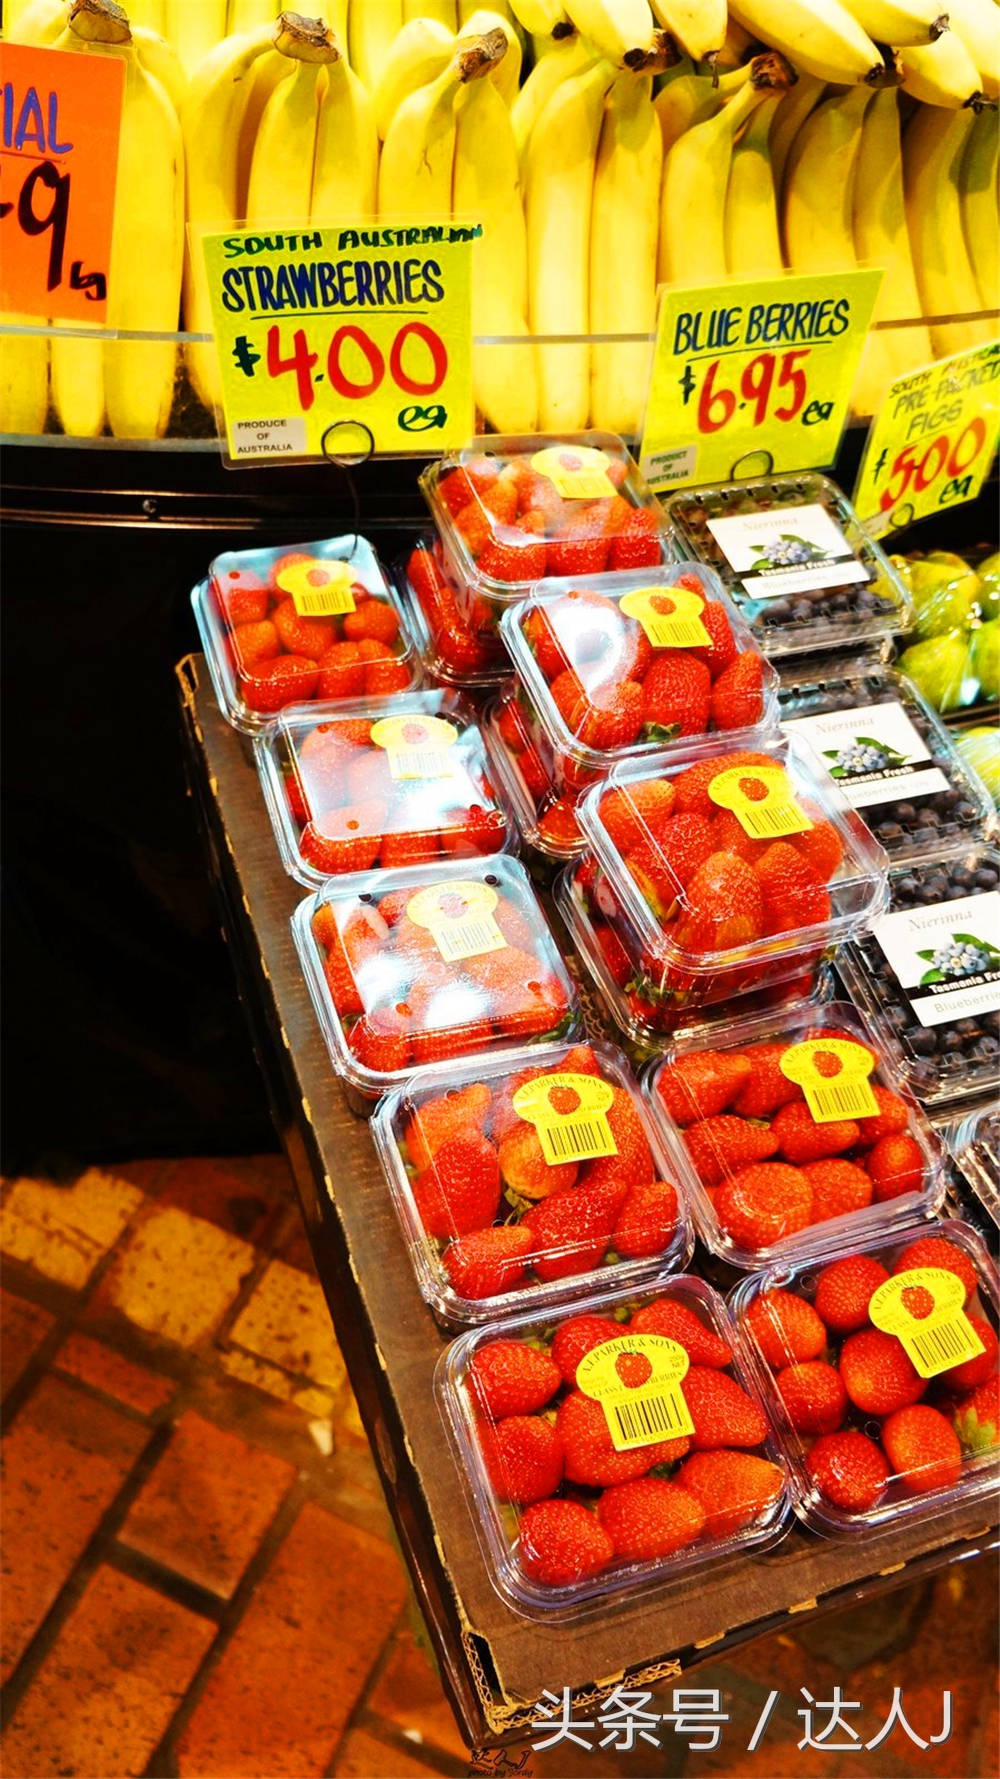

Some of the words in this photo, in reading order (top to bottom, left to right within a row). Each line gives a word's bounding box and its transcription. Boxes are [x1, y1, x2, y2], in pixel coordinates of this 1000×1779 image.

[0, 83, 74, 154] IAL
[223, 232, 323, 258] SOUTH
[222, 259, 445, 313] STRAWBERRIES
[673, 306, 743, 356] BLUE
[745, 298, 850, 345] BERRIES
[802, 400, 835, 426] ea
[906, 399, 963, 441] FIGS
[237, 419, 287, 430] PRODUCE
[257, 432, 270, 440] OF
[237, 443, 293, 454] AUSTRALIA
[650, 450, 688, 465] PRODUCT
[816, 718, 874, 734] Nierinna
[883, 766, 915, 778] Fresh
[908, 910, 973, 931] Nierinna
[928, 975, 985, 994] Tasmania
[637, 1336, 647, 1348] &
[649, 1338, 677, 1353] SONS
